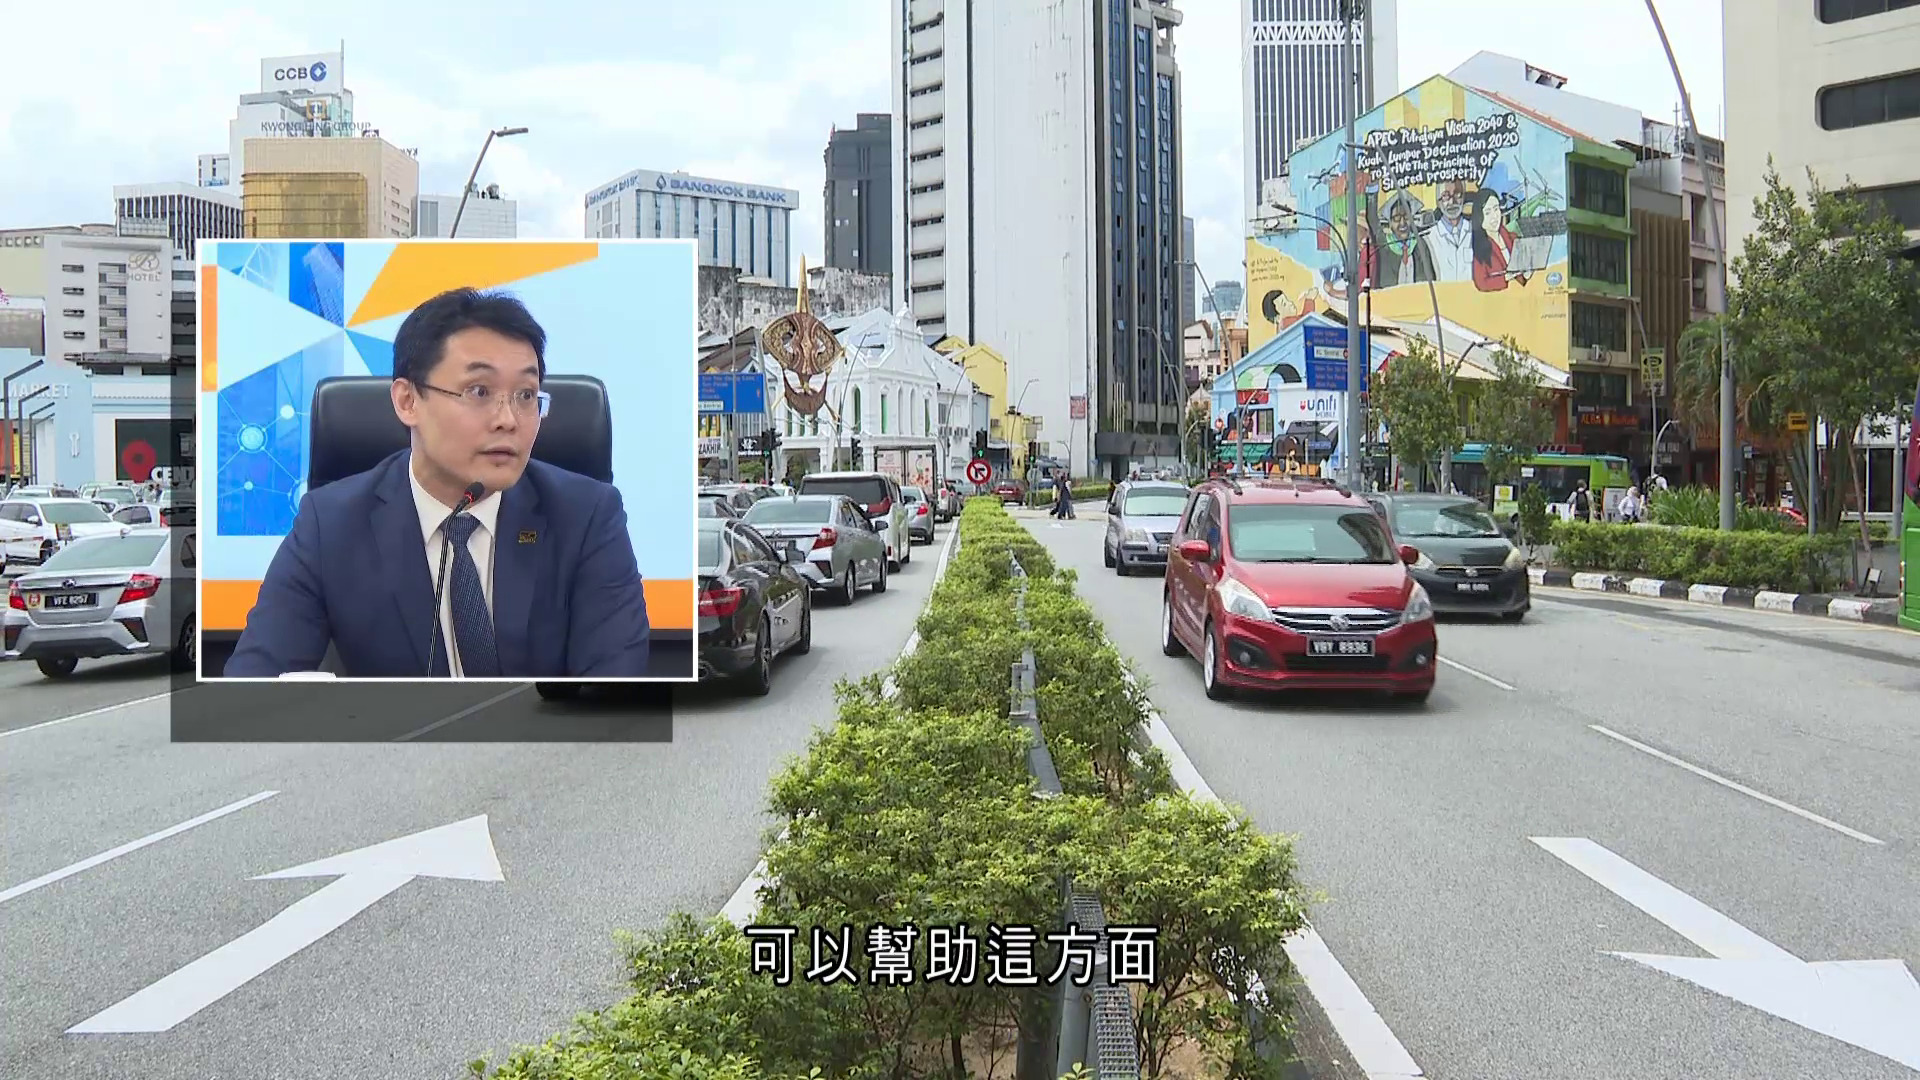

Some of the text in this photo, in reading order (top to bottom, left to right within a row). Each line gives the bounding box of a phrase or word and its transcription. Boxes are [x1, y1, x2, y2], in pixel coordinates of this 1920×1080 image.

[274, 67, 308, 80] CCB
[333, 121, 371, 132] GROUP
[1367, 130, 1398, 148] APEC
[1401, 125, 1444, 145] Putrajaya
[1446, 120, 1475, 136] Vision
[1476, 115, 1503, 133] 2040
[1388, 150, 1421, 164] Lumpur
[1422, 136, 1486, 159] Declaration
[1487, 132, 1518, 149] 2020
[670, 179, 787, 203] BANGKOK BANK
[127, 272, 161, 282] HOTEL
[9, 383, 70, 398] MARKET
[1307, 394, 1337, 411] unifi
